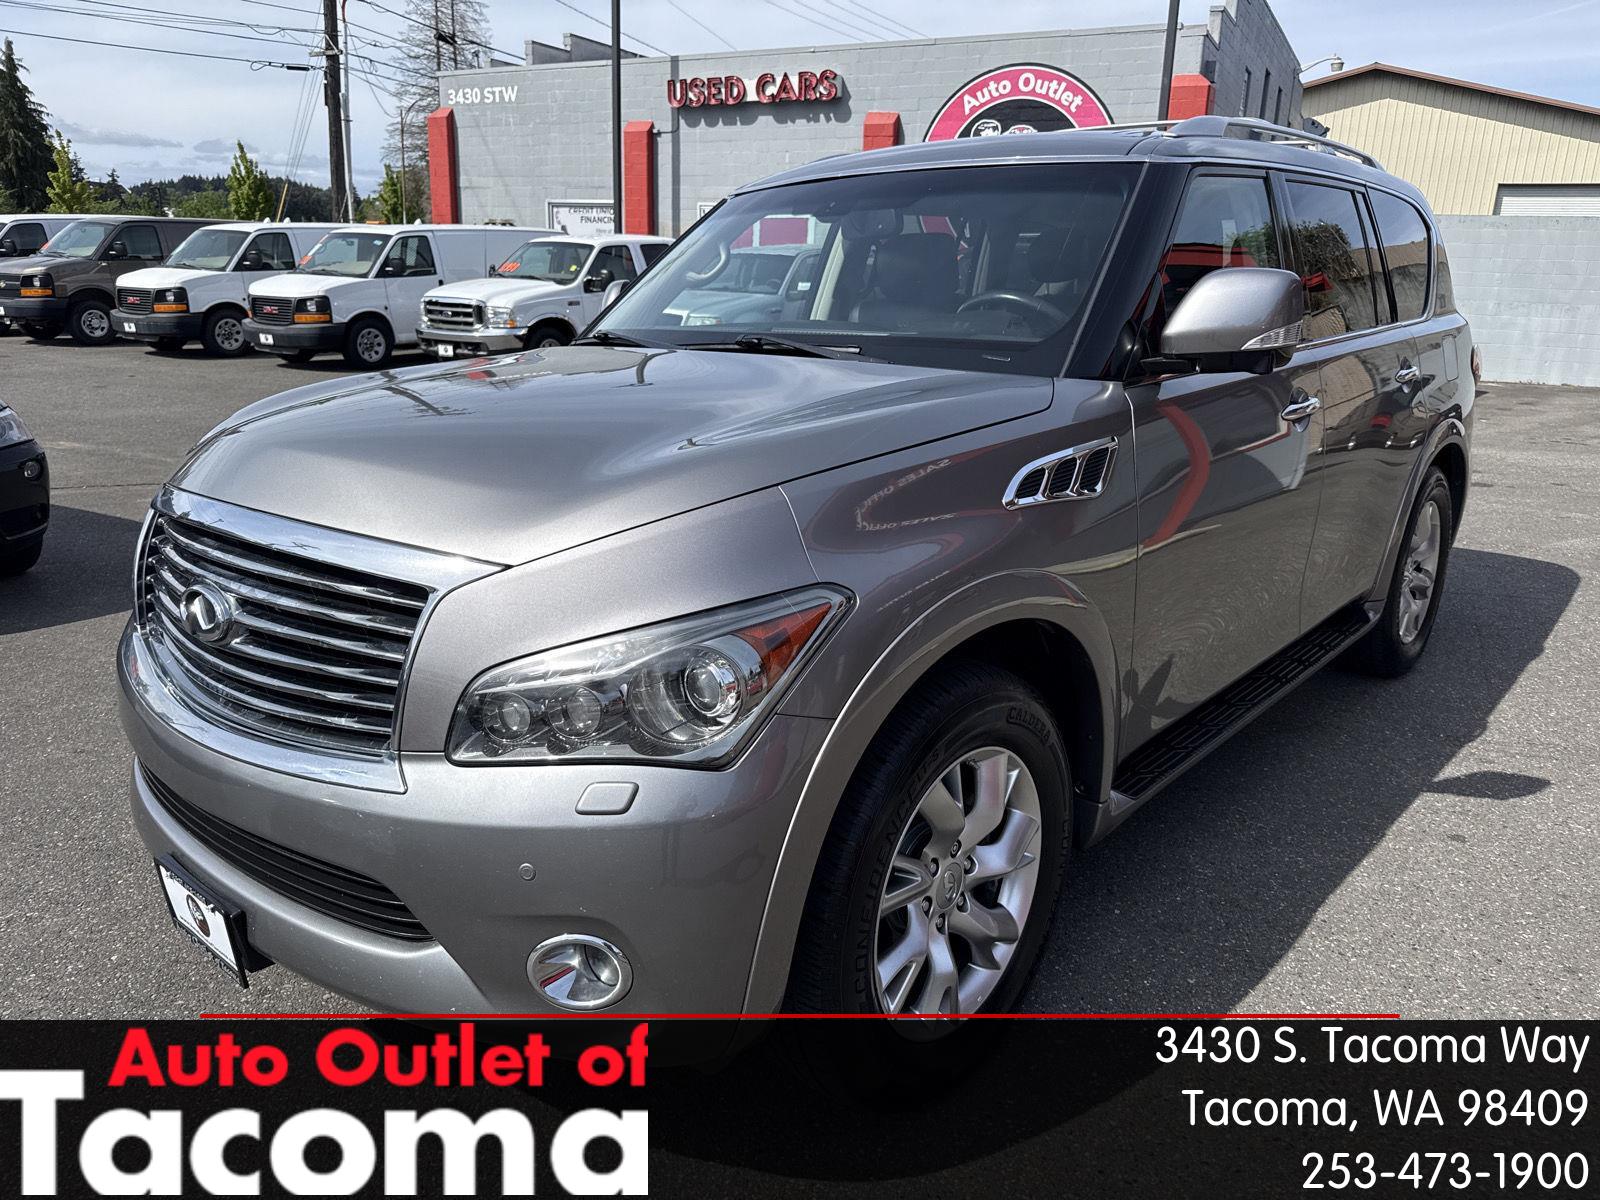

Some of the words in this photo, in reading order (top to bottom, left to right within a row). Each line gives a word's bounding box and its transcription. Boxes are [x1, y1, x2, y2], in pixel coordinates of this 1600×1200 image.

[447, 87, 481, 105] 3430
[483, 85, 518, 103] STW
[667, 75, 746, 109] USED
[755, 69, 839, 104] CARS
[962, 79, 1012, 115] Auto
[1017, 72, 1083, 113] Outlet
